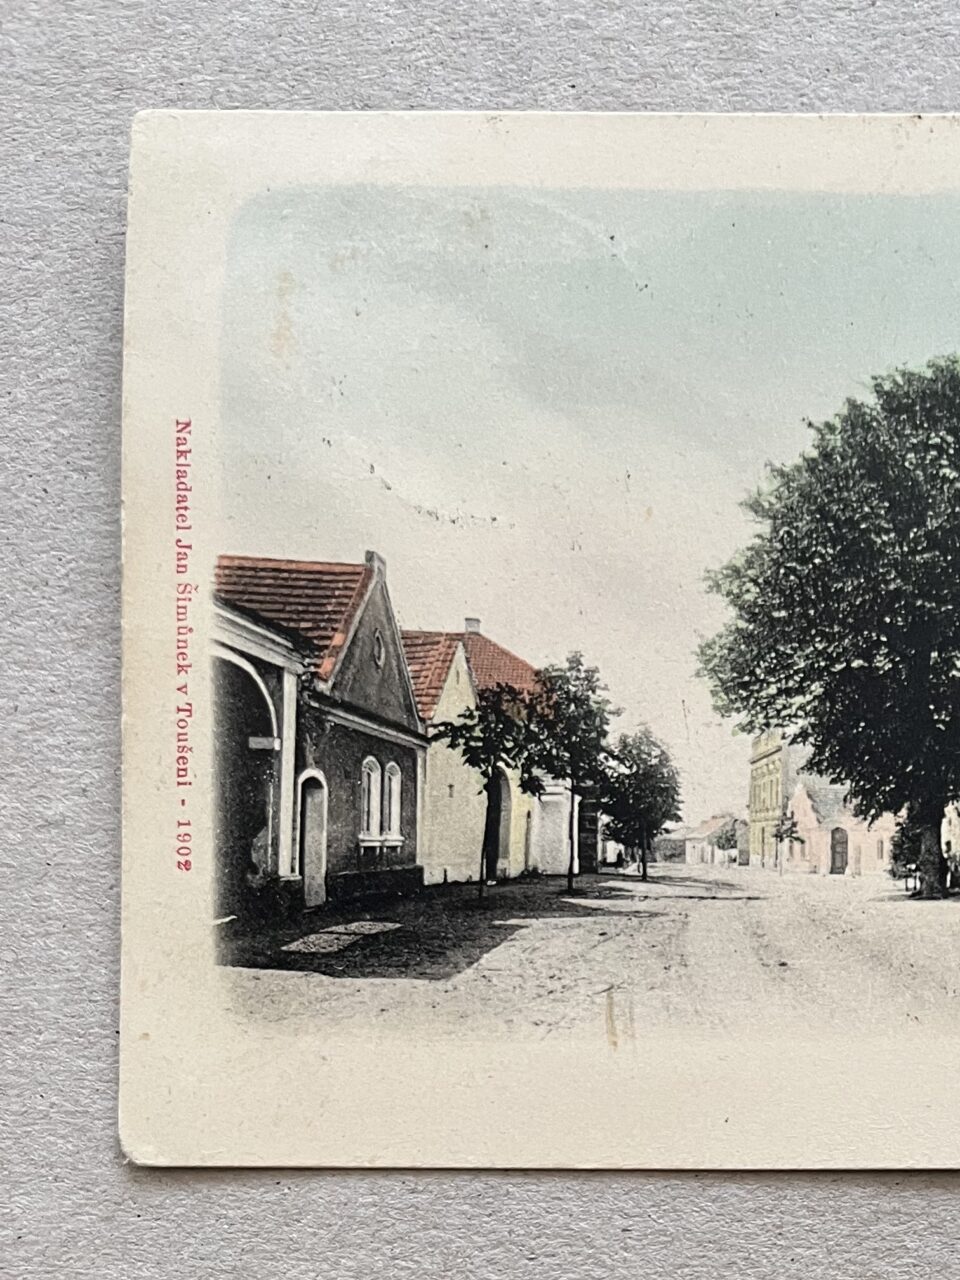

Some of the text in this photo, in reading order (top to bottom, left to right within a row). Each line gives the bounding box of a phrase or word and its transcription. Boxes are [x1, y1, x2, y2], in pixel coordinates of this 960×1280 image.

[174, 419, 192, 531] Nakladatel
[174, 537, 192, 574] Jan
[174, 582, 199, 675] Šimůnek
[175, 683, 189, 696] v
[175, 702, 194, 788] Toušeni
[175, 819, 192, 872] 1902
